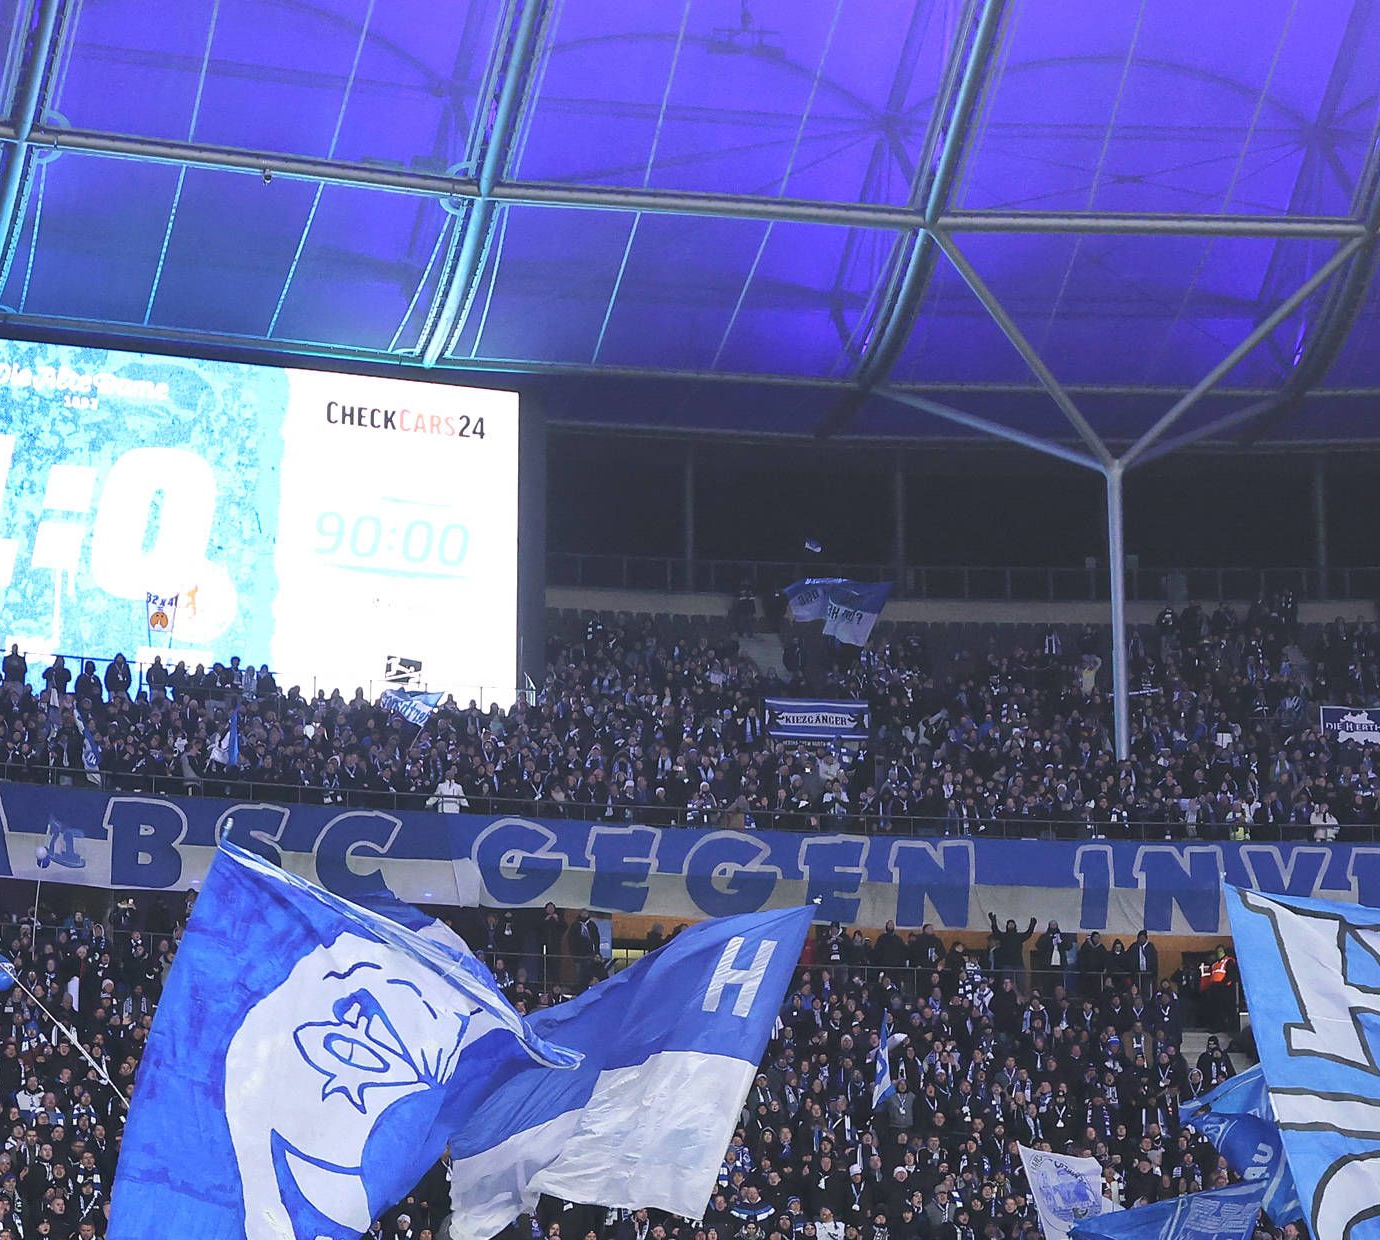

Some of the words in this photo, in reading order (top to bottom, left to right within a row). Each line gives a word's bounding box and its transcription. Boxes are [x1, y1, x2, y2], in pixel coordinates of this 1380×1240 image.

[313, 510, 471, 569] 90:00
[1325, 721, 1343, 731] DIE
[104, 796, 404, 902] BSC
[469, 816, 977, 930] GEGEN
[702, 935, 778, 1019] H
